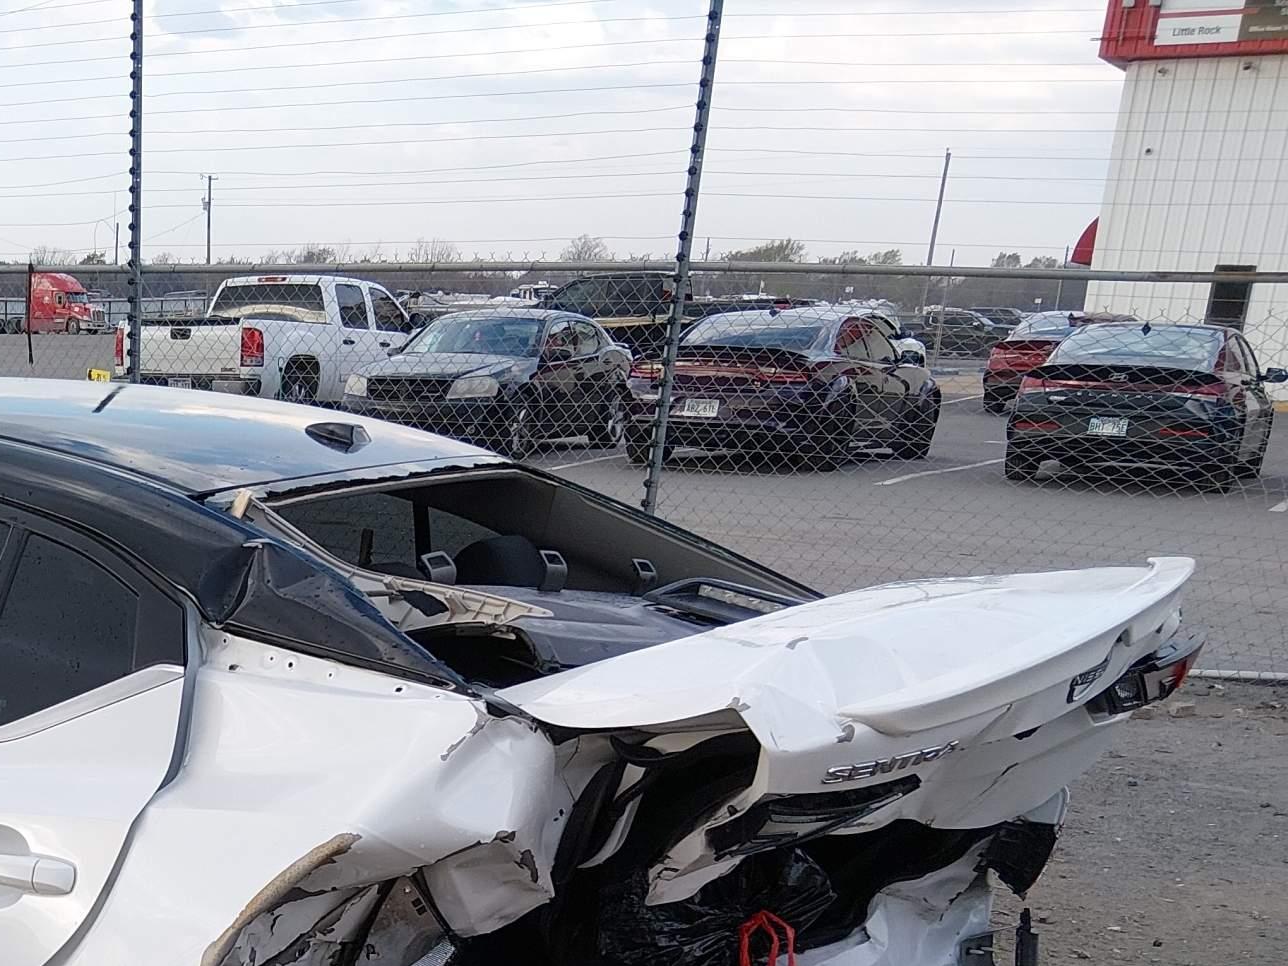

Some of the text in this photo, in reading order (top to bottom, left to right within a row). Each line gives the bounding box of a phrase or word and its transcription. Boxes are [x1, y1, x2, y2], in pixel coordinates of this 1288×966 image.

[1172, 26, 1221, 36] Little Rock
[821, 740, 959, 784] SENTRA
